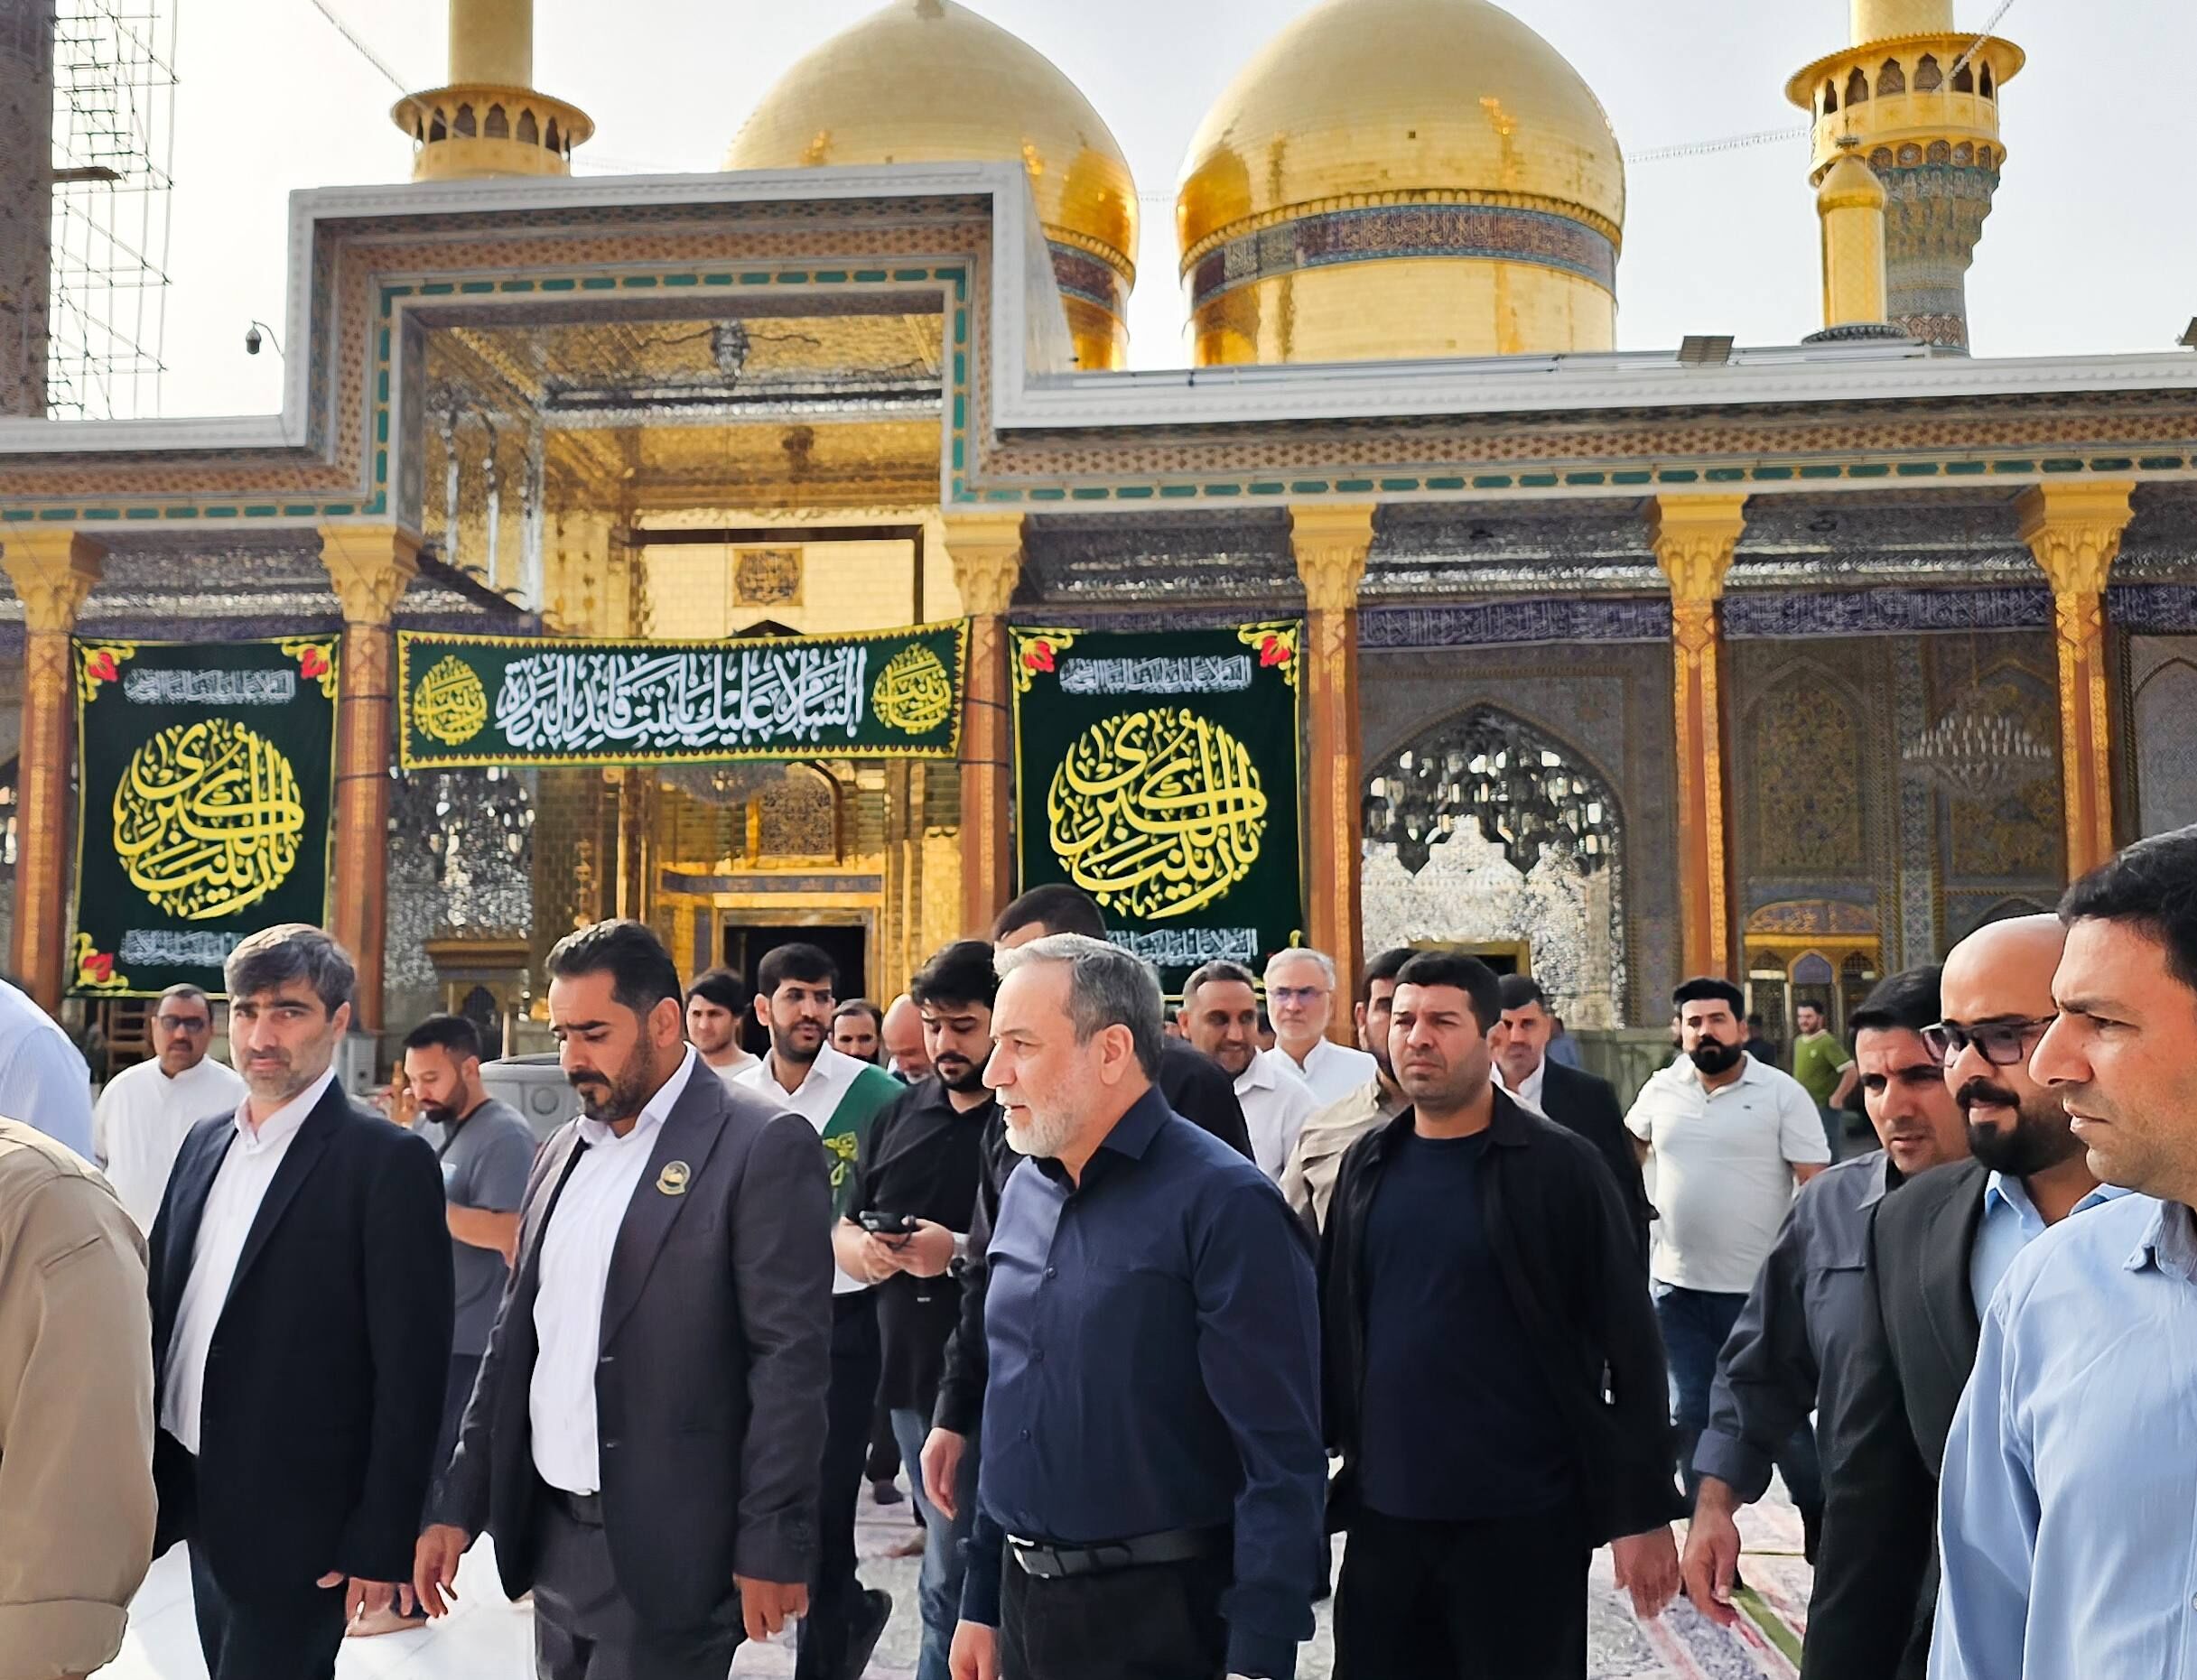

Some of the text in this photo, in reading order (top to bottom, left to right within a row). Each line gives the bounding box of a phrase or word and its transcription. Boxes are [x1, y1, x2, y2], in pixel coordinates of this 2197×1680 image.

[774, 645, 867, 738] السلام
[128, 838, 272, 920] زينب
[1071, 827, 1234, 920] زينب
